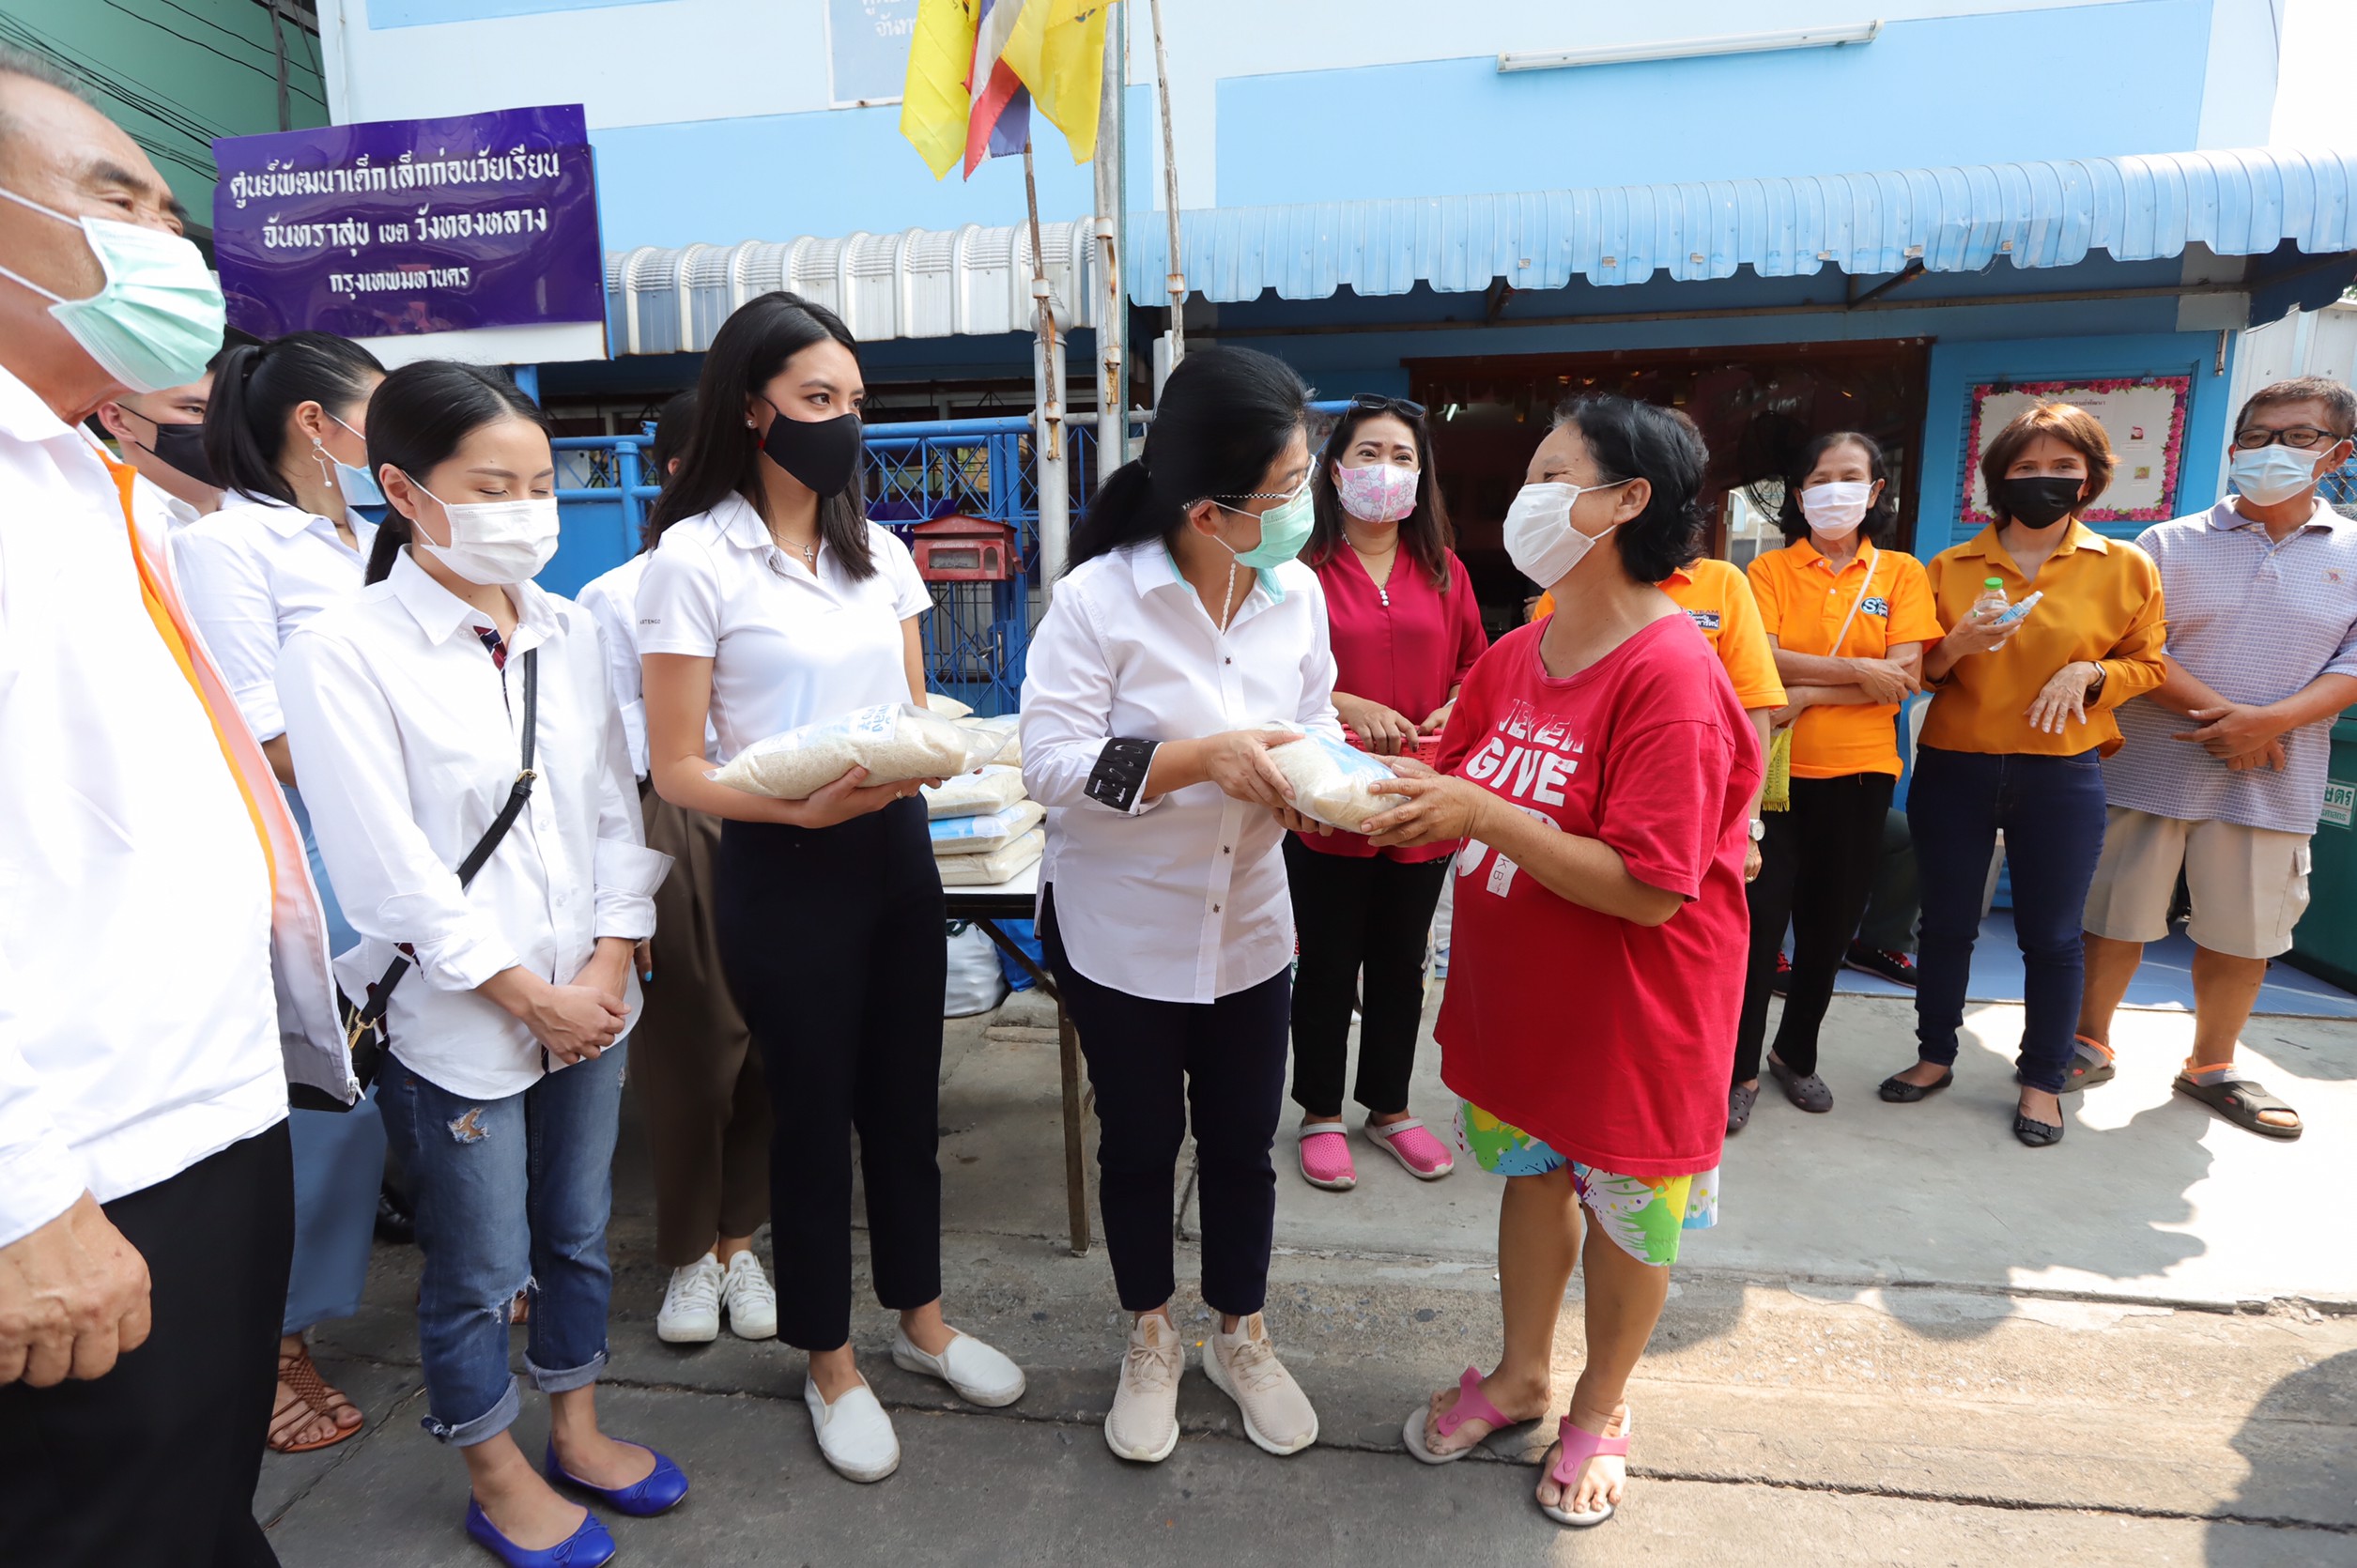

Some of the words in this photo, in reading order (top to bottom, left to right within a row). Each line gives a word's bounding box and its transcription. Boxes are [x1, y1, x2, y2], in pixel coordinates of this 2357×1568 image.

[262, 216, 371, 257] จันทราสุข
[378, 221, 409, 244] เขต
[414, 203, 548, 242] วังทองหลาง
[329, 267, 470, 300] กรุงเทพมหานคร
[1466, 737, 1579, 807] GIVE
